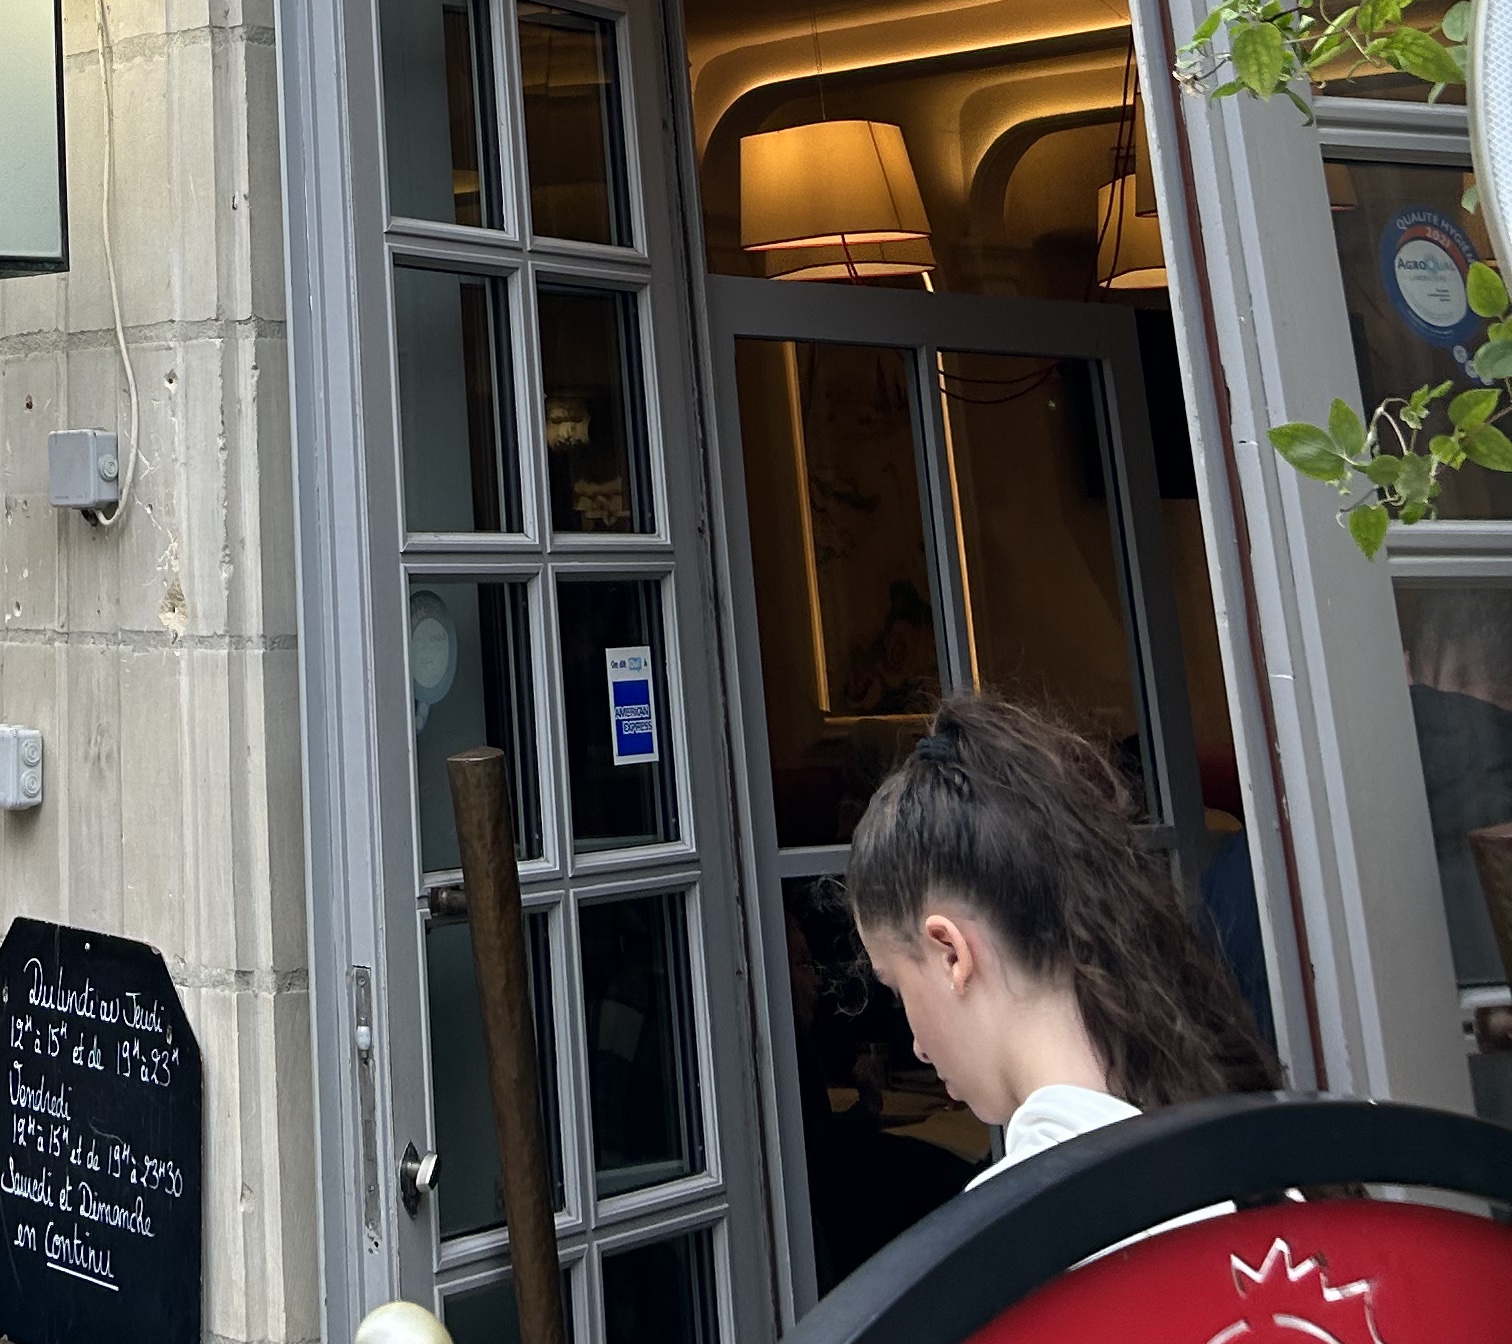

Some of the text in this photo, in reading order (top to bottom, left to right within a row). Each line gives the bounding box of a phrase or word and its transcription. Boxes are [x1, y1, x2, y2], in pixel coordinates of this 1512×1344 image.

[614, 705, 650, 719] AMERICAN
[622, 720, 653, 733] EXPRESS
[22, 957, 55, 1010] Du
[99, 997, 120, 1024] au
[122, 991, 165, 1033] Jeudi
[34, 1029, 43, 1055] à
[72, 1031, 84, 1067] et
[87, 1034, 105, 1071] de
[8, 1059, 73, 1121] Vendredi
[70, 1134, 83, 1166] et
[86, 1138, 101, 1172] de
[0, 1155, 156, 1238] Samedi et Dimanche
[13, 1220, 115, 1279] en Continu
